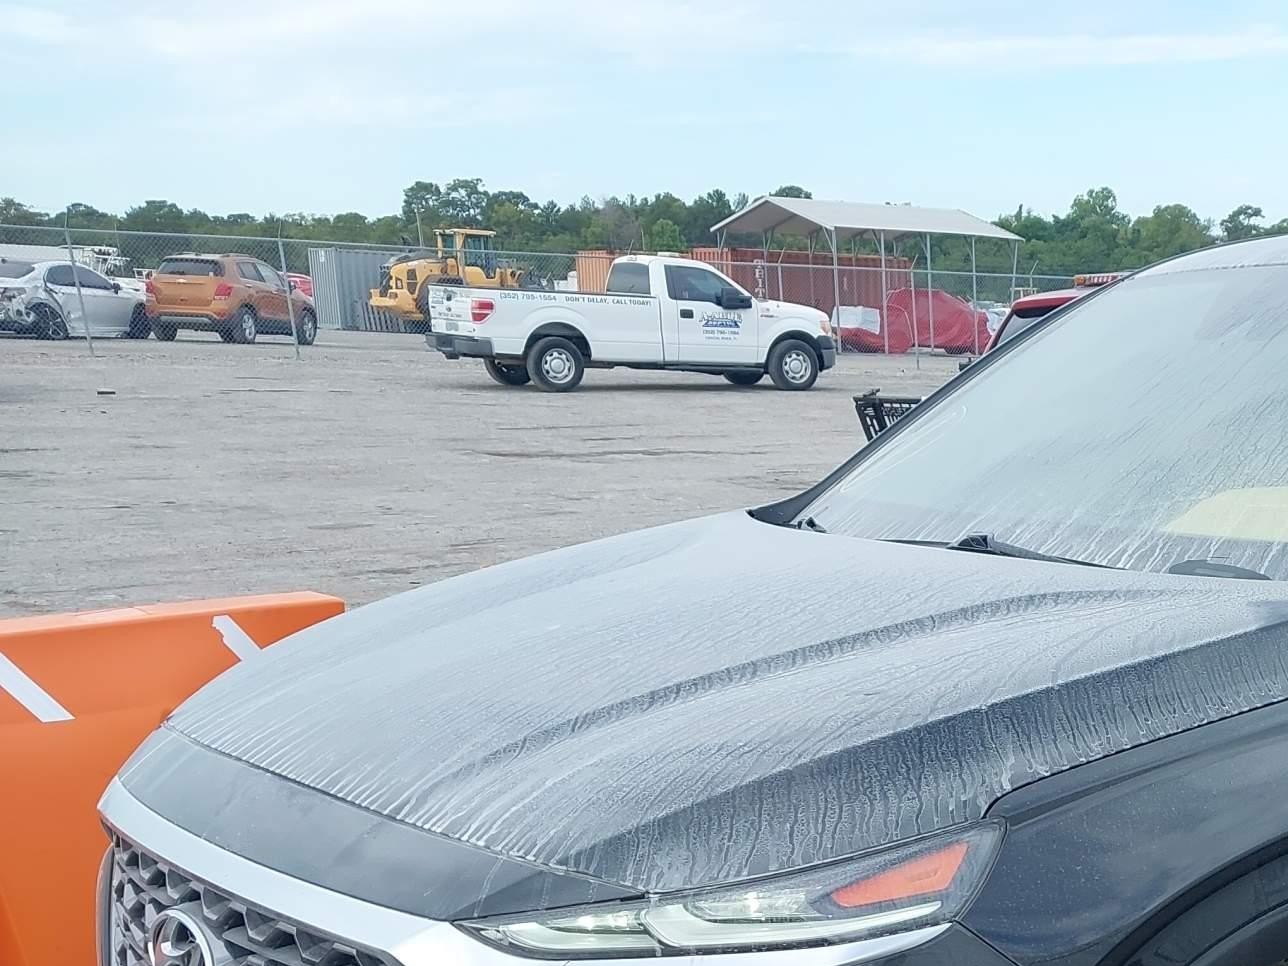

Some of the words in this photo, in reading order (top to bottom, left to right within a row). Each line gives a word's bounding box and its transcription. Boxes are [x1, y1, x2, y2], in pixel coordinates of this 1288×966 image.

[499, 291, 519, 300] (352)
[564, 295, 586, 303] DON'T
[611, 297, 627, 305] CALL
